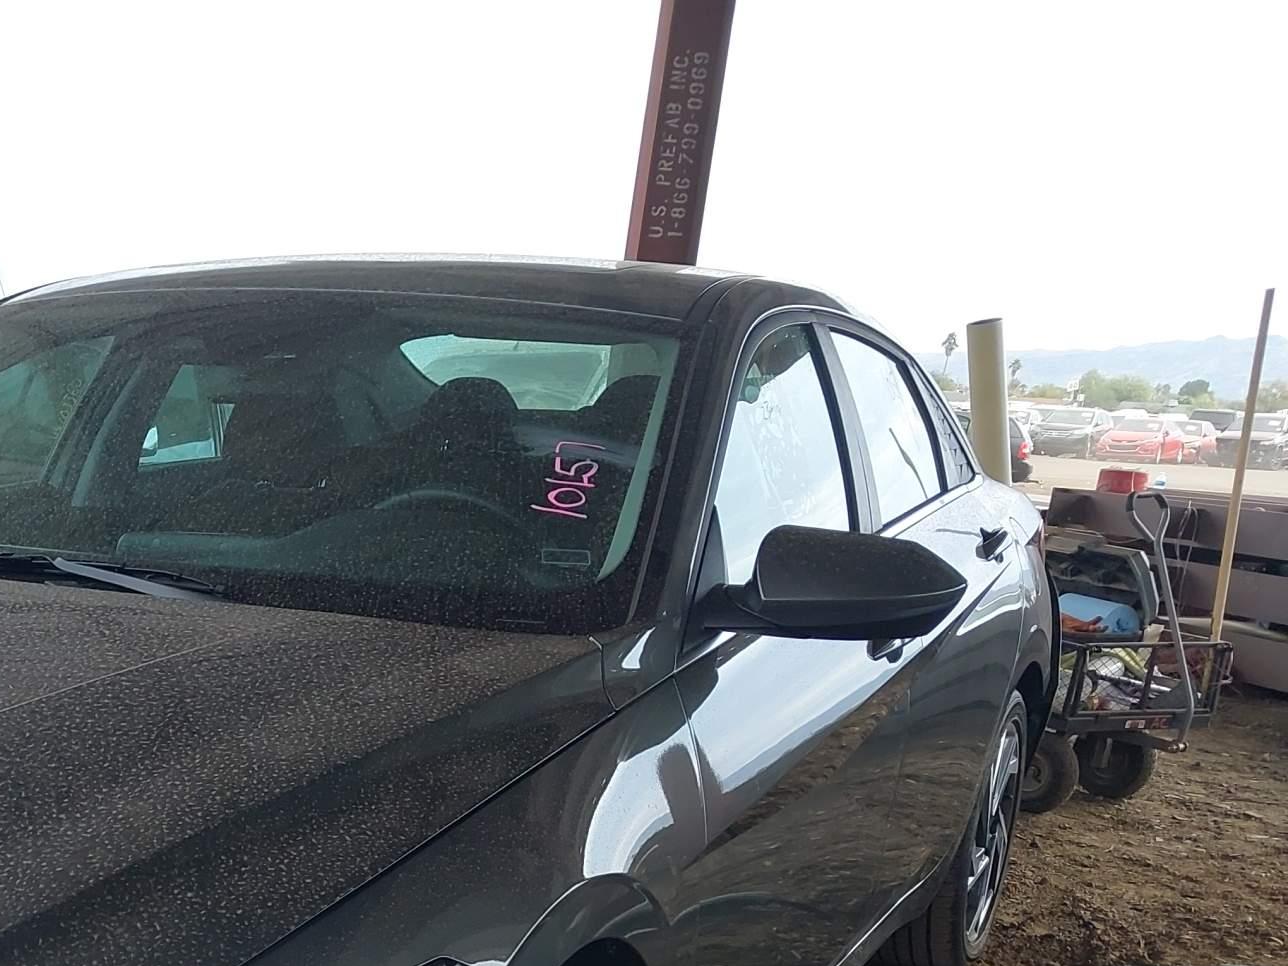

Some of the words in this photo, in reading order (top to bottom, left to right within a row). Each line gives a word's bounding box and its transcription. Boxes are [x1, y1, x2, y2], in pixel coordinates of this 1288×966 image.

[669, 49, 691, 91] INC.
[656, 102, 682, 186] PREFAB
[667, 51, 710, 237] 1-866-799-0969
[648, 199, 668, 238] U.S.
